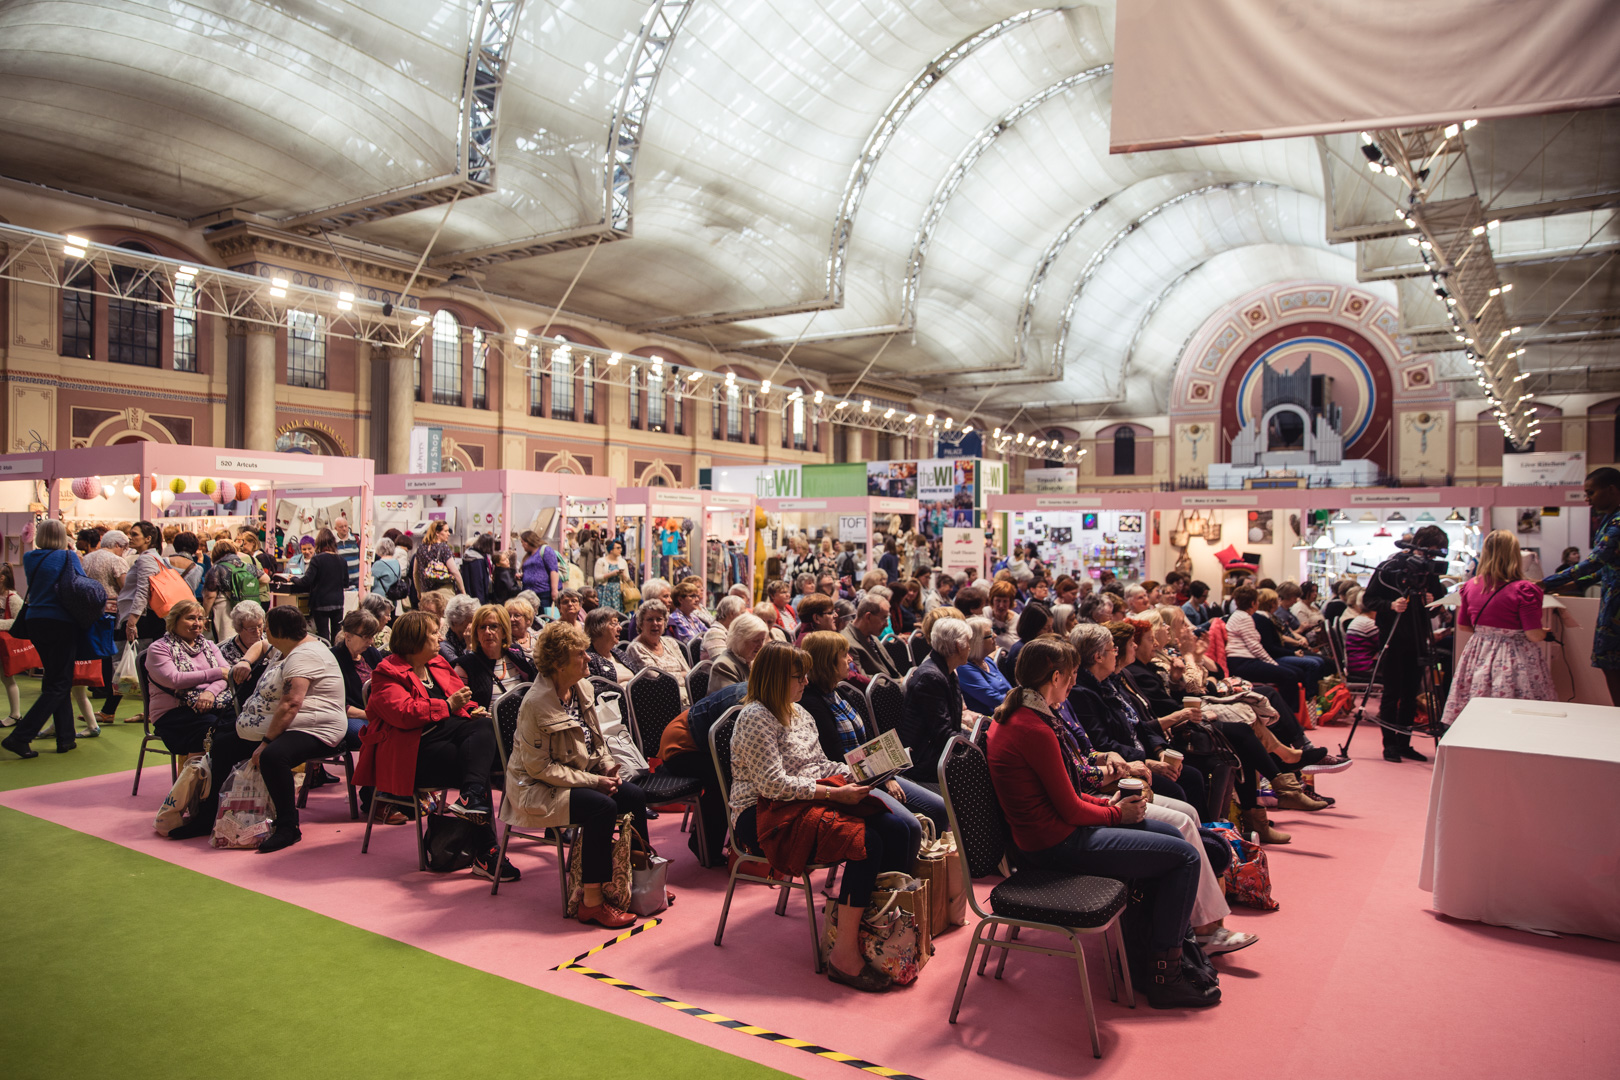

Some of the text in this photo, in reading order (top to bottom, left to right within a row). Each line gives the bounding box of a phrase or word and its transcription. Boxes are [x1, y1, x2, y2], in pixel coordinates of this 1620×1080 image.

[278, 419, 300, 435] HALL
[303, 419, 311, 427] &
[313, 420, 335, 436] PALM
[430, 434, 439, 457] Shop
[236, 461, 258, 469] Artcuts
[883, 735, 893, 749] WEEK
